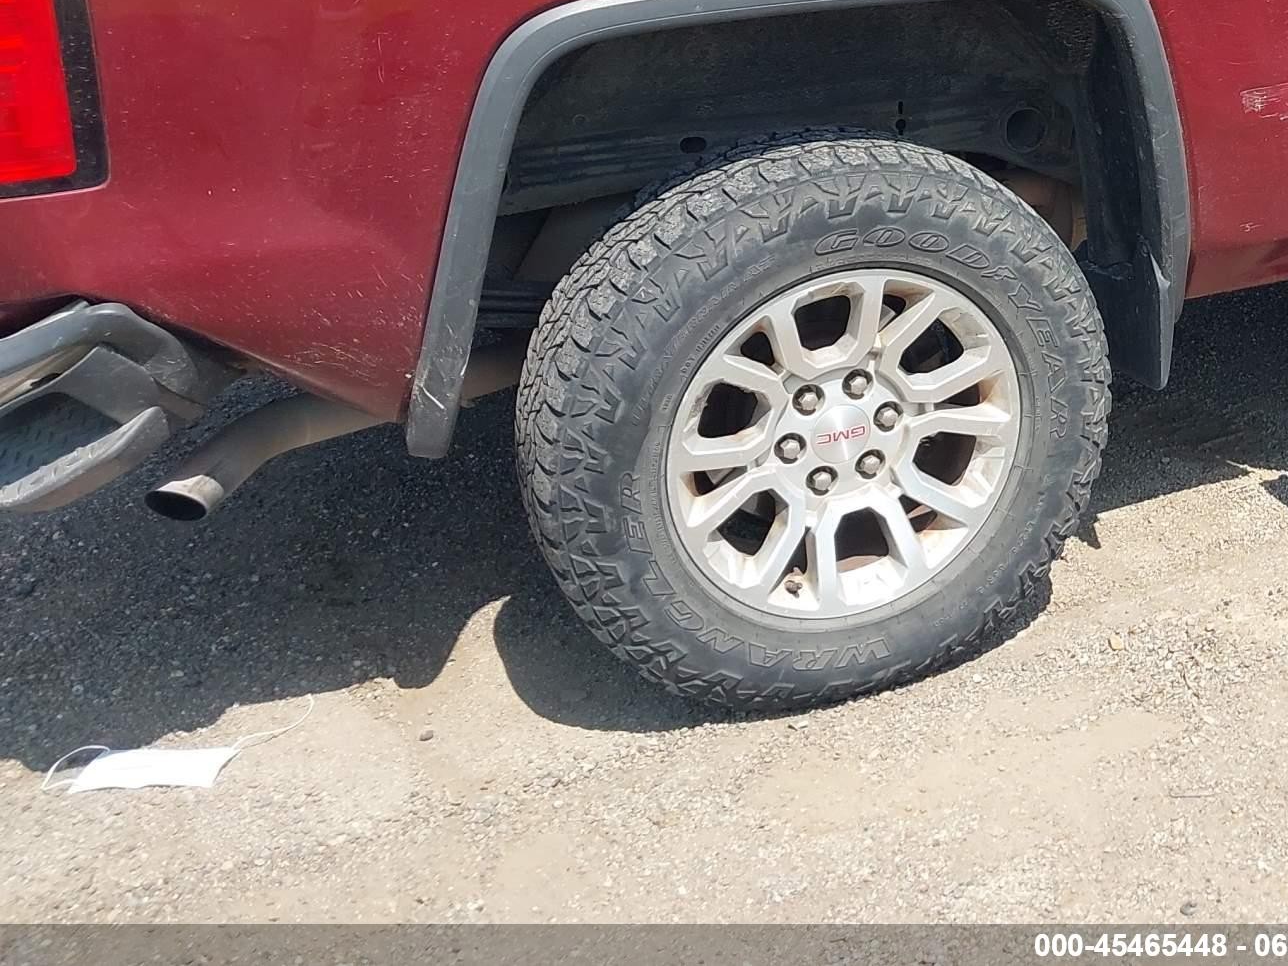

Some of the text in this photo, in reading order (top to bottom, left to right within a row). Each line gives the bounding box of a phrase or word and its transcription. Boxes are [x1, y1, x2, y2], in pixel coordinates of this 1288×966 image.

[814, 225, 1069, 440] GOODYEAR
[816, 425, 866, 445] GMC
[618, 470, 893, 671] WRANGLER
